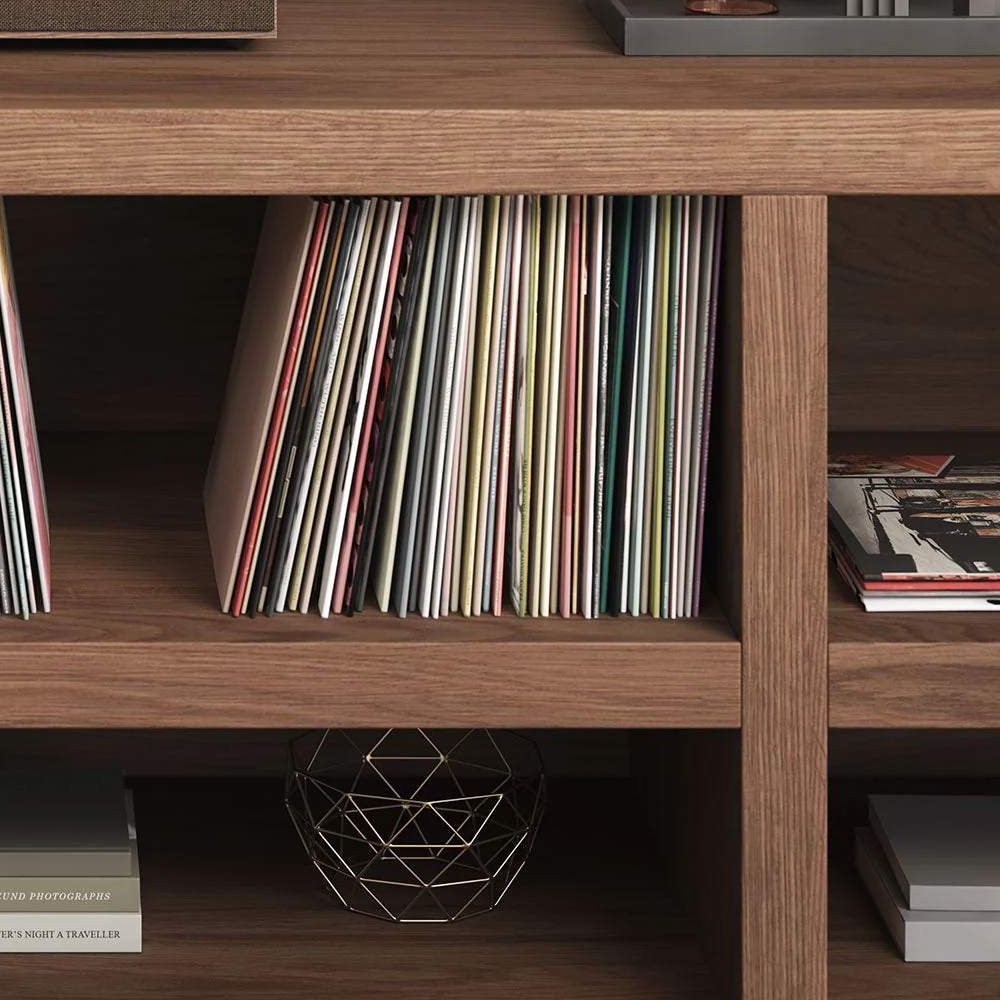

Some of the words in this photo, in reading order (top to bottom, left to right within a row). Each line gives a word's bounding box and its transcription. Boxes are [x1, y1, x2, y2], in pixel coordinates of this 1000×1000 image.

[29, 892, 111, 901] PHOTOGRAPHS
[25, 930, 55, 939] NIGHT
[56, 930, 65, 939] A
[65, 930, 121, 939] TRAVELLER
